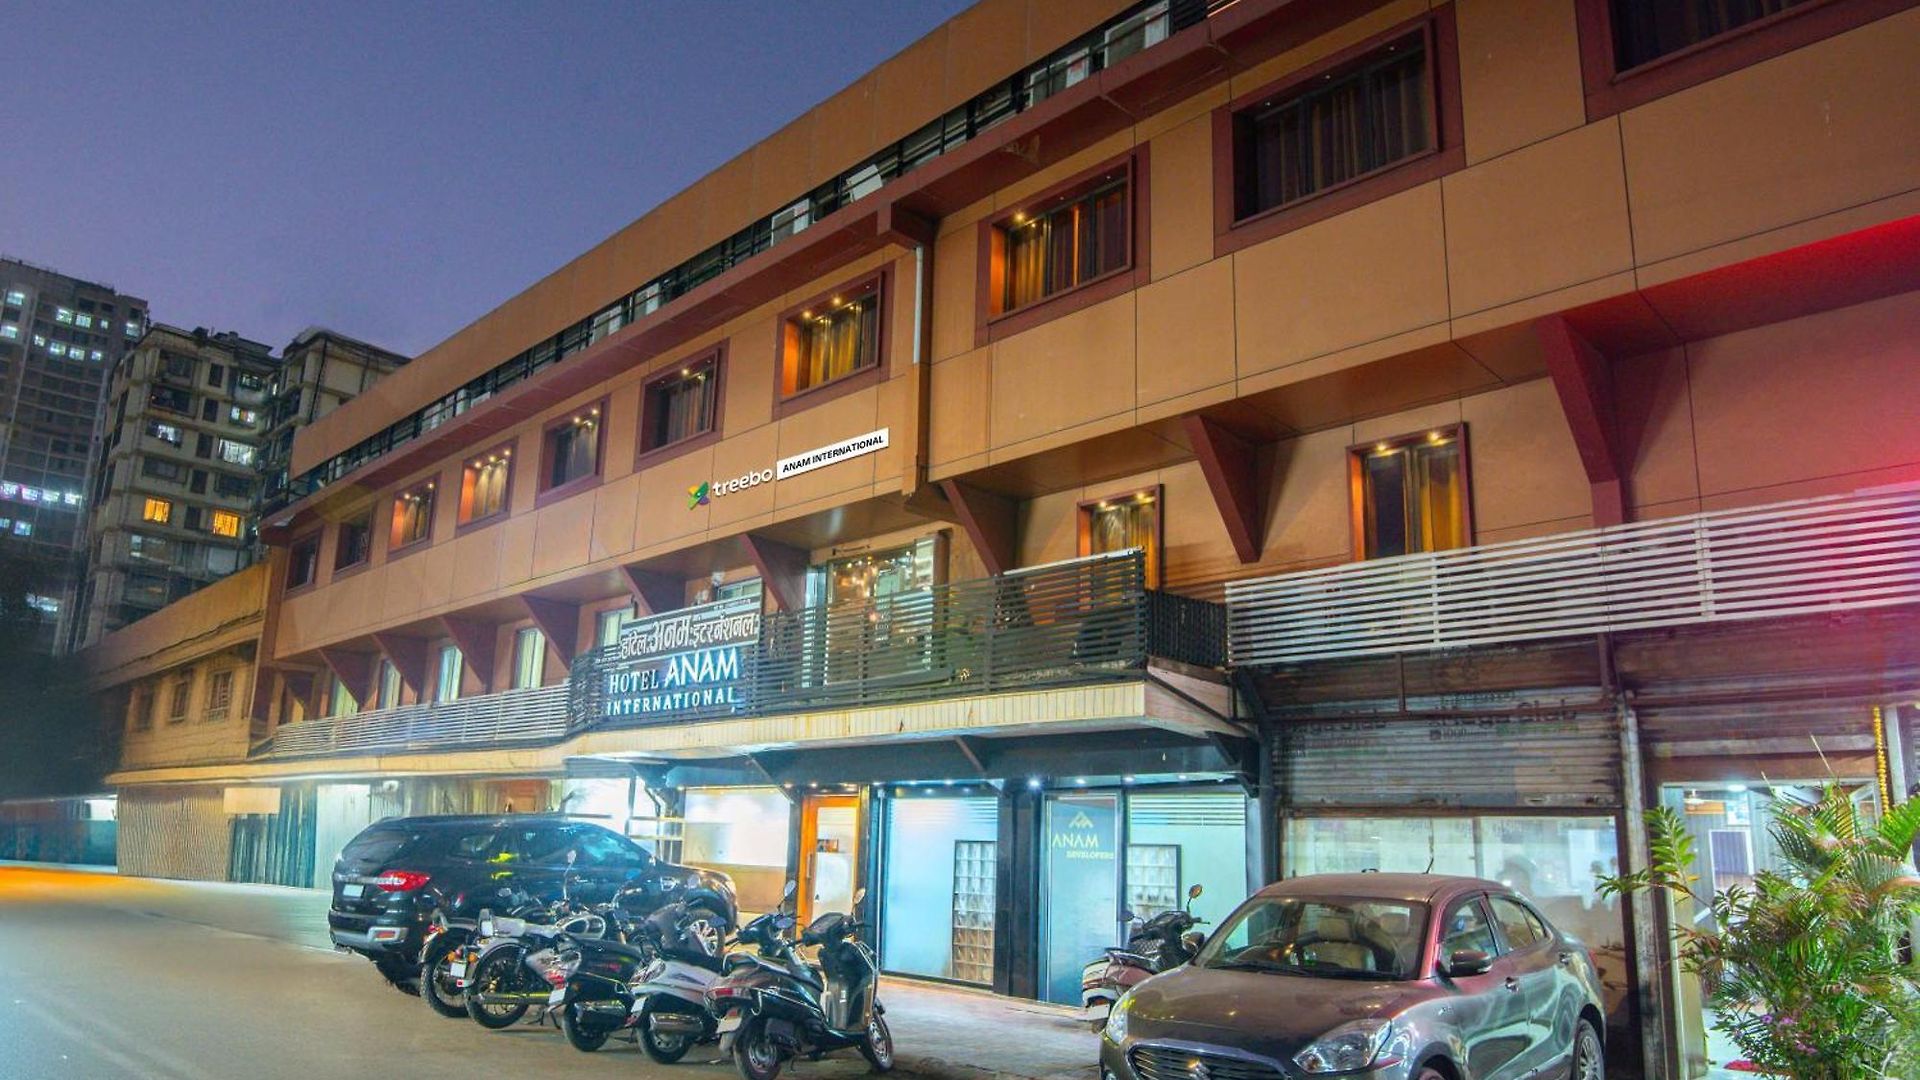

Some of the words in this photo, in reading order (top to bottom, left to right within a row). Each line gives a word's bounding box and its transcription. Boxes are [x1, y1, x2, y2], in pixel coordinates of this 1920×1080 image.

[782, 456, 811, 473] ANAM
[812, 434, 884, 464] INTERNATIONAL
[713, 467, 773, 496] treebo
[608, 669, 659, 695] HOTEL
[663, 647, 738, 688] ANAM
[607, 687, 736, 716] INTERNATIONAL
[1052, 832, 1099, 849] ANAM
